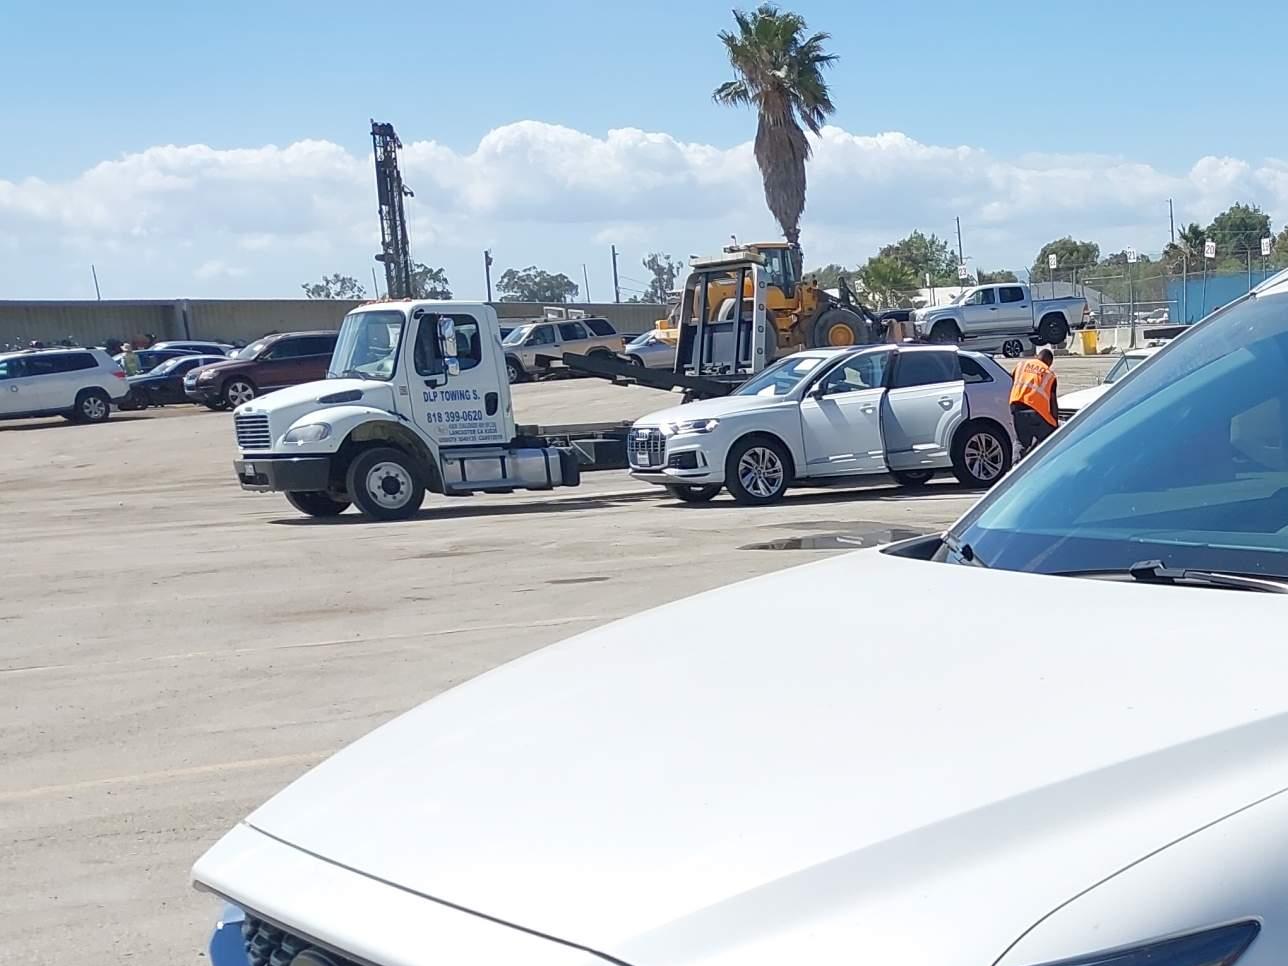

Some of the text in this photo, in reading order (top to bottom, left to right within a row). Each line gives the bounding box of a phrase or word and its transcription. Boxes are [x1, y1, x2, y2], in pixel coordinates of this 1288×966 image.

[423, 391, 438, 402] DLP
[441, 390, 471, 402] TOWING
[427, 410, 483, 423] 818 399-0620
